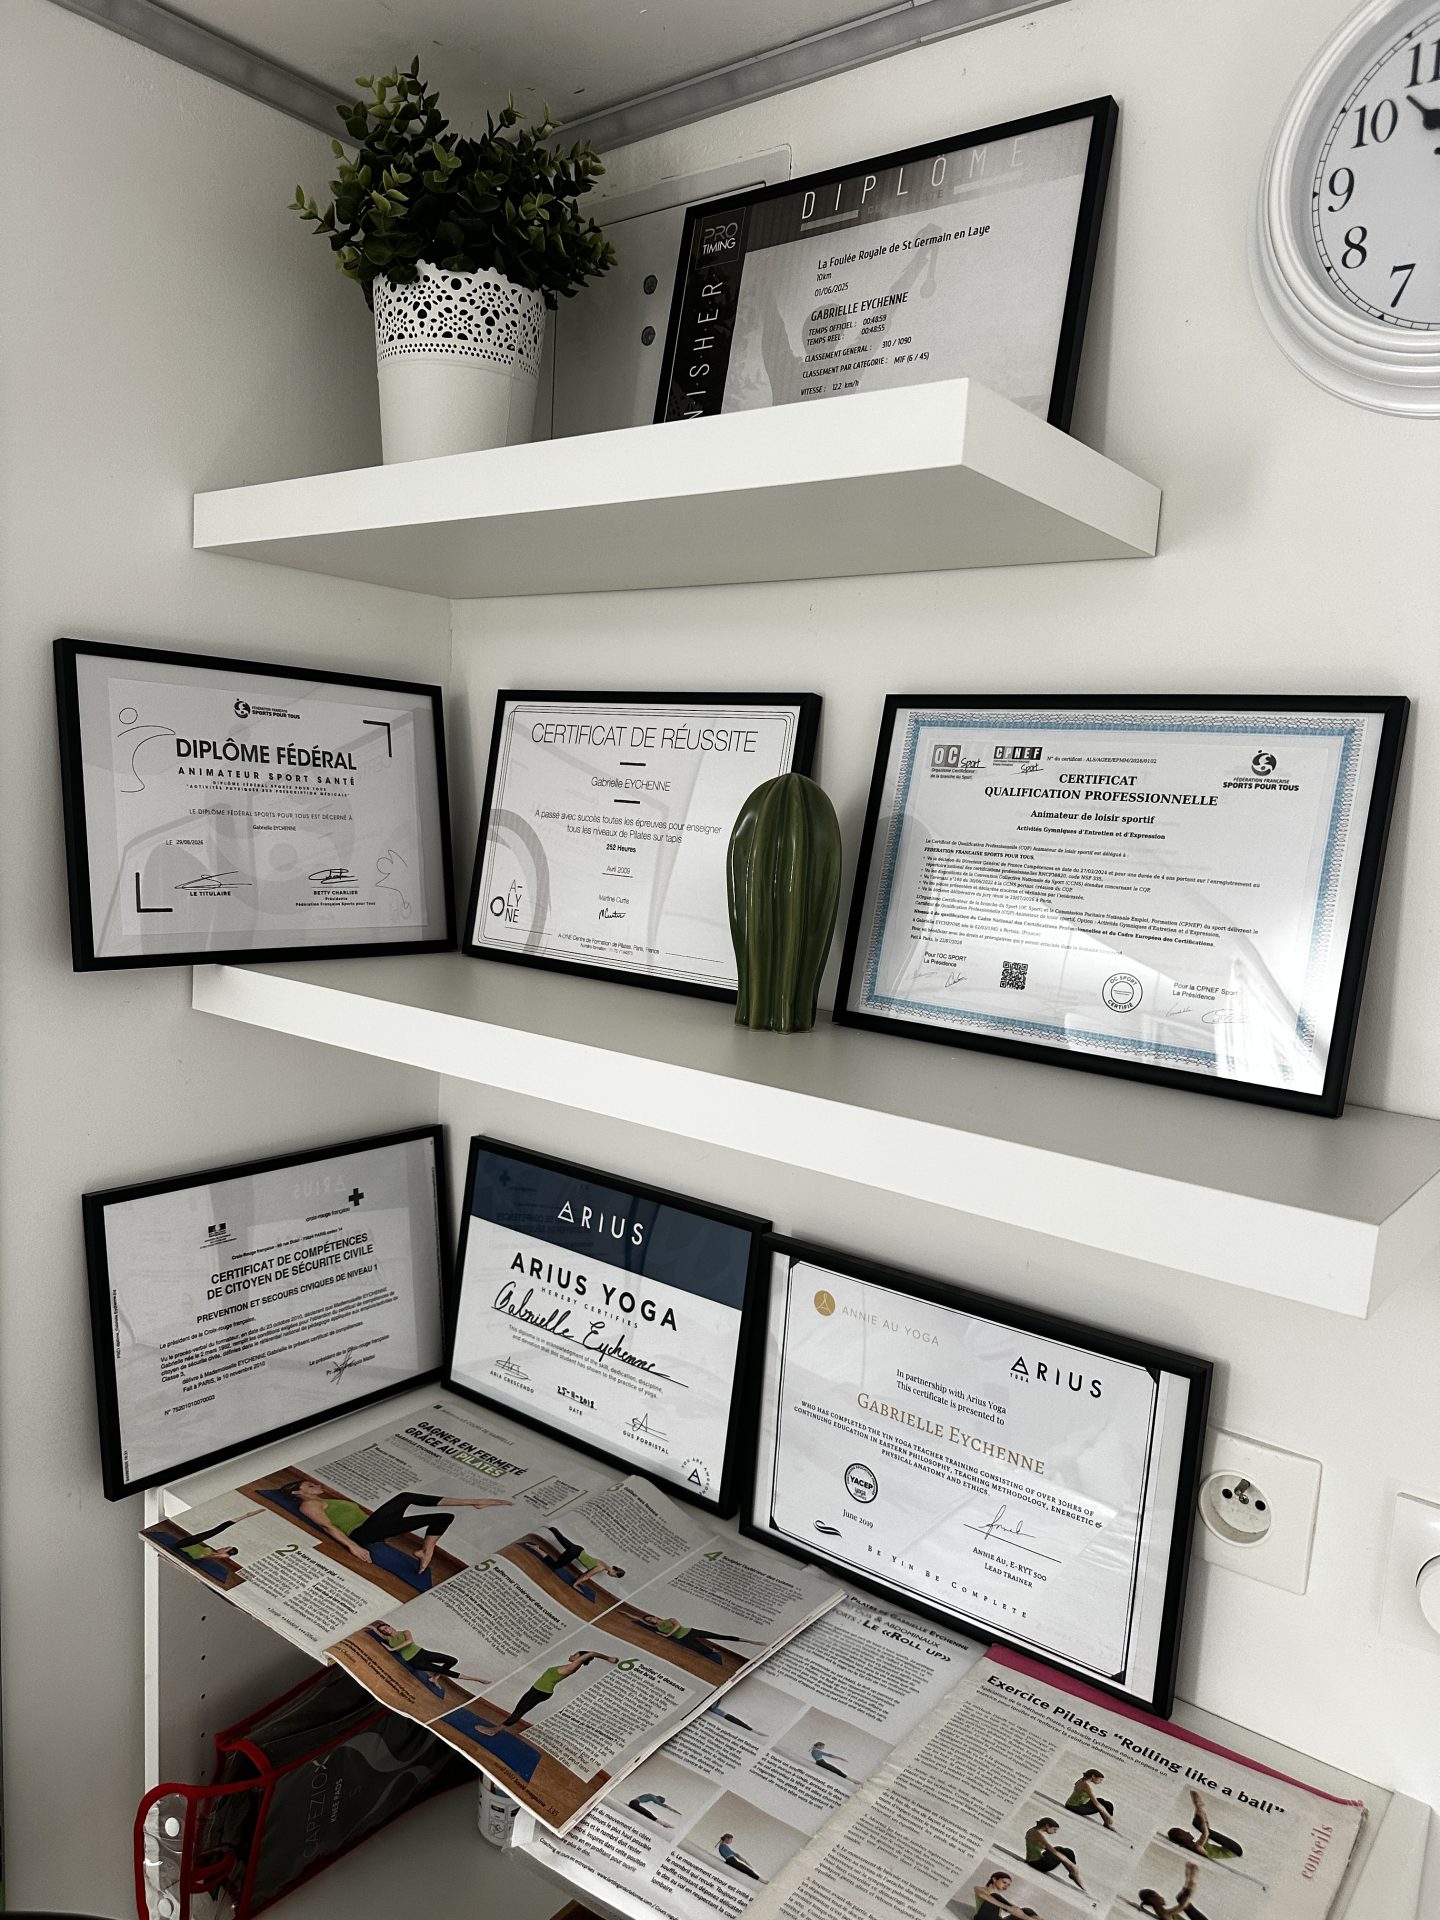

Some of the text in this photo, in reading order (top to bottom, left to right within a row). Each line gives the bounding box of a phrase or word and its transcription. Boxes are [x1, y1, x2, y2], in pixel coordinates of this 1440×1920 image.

[1351, 98, 1399, 149] 10
[801, 136, 1028, 220] DIPLÔME
[1327, 167, 1355, 213] 9
[702, 237, 736, 256] TIMING
[704, 222, 738, 243] PRO
[817, 225, 990, 269] La Foulée Royale de St Germain en Laye
[1341, 225, 1368, 269] 8
[814, 282, 849, 297] 01/06/2025
[816, 272, 831, 281] 10km
[1390, 263, 1417, 308] 7
[810, 292, 908, 321] GABRIELLE EYCHENNE
[531, 722, 758, 752] CERTIFICAT DE RÉUSSITE
[176, 737, 357, 770] DIPLÔME FÉDÉRAL
[934, 746, 959, 765] OC
[995, 746, 1042, 760] CPNEF
[178, 766, 355, 786] ANIMATEUR SPORT SANTÉ
[590, 776, 671, 791] Gabrielle EYCHENNE
[1058, 773, 1137, 785] CERTIFICAT
[1222, 781, 1252, 789] SPORTS
[1254, 782, 1276, 790] POUR
[984, 786, 1218, 805] QUALIFICATION PROFESSIONNELLE
[540, 810, 560, 819] passé
[560, 812, 576, 820] avec
[577, 814, 600, 823] succès
[602, 815, 622, 825] toutes
[623, 816, 633, 826] les
[635, 817, 667, 829] épreuves
[667, 822, 685, 830] pour
[686, 823, 722, 835] enseigner
[1030, 810, 1155, 824] Animateur de loisir sportif
[1043, 826, 1076, 834] Gymniques
[1123, 831, 1165, 839] d'Expression
[616, 866, 630, 874] 2009
[924, 950, 944, 958] Pour
[945, 952, 958, 960] l'OC
[557, 1200, 644, 1245] ARIUS
[206, 1243, 373, 1300] DE CITOYEN DE SÉCURITE CIVILE
[210, 1233, 368, 1284] CERTIFICAT DE COMPÉTENCES
[196, 1301, 248, 1323] PREVENTION
[249, 1298, 260, 1307] ET
[261, 1287, 298, 1304] SECOURS
[300, 1276, 334, 1292] CIVIQUES
[335, 1272, 345, 1282] DE
[346, 1264, 372, 1278] NIVEAU
[510, 1252, 677, 1332] ARIUS YOGA
[841, 1305, 939, 1347] ANNIE AU YOGA
[896, 1368, 1006, 1414] In partnership with Arius Yoga
[1010, 1355, 1102, 1399] ARIUS
[568, 1405, 583, 1416] DATE
[896, 1380, 1004, 1425] This certificate is presented to
[622, 1430, 669, 1455] GUS FORRISTAL
[857, 1392, 1046, 1475] GABRIELLE EYCHENNE
[405, 1427, 502, 1477] GRÂCE AU PILATES
[418, 1421, 460, 1448] GAGNER
[457, 1441, 477, 1453] EN
[472, 1448, 529, 1476] FERMETÉ
[850, 1475, 874, 1490] YACEP
[275, 1544, 299, 1557] 2
[474, 1558, 496, 1572] 5
[704, 1551, 723, 1561] 4
[972, 1547, 1046, 1582] ANNIE AU, E-RYT 500
[867, 1544, 1027, 1618] BE YIN BE COMPLETE
[984, 1562, 1032, 1588] LEAD TRAINER
[617, 1658, 640, 1671] 6
[987, 1675, 1285, 1815] Exercice Pilates “Rolling like a ball”
[1301, 1823, 1334, 1880] conseils
